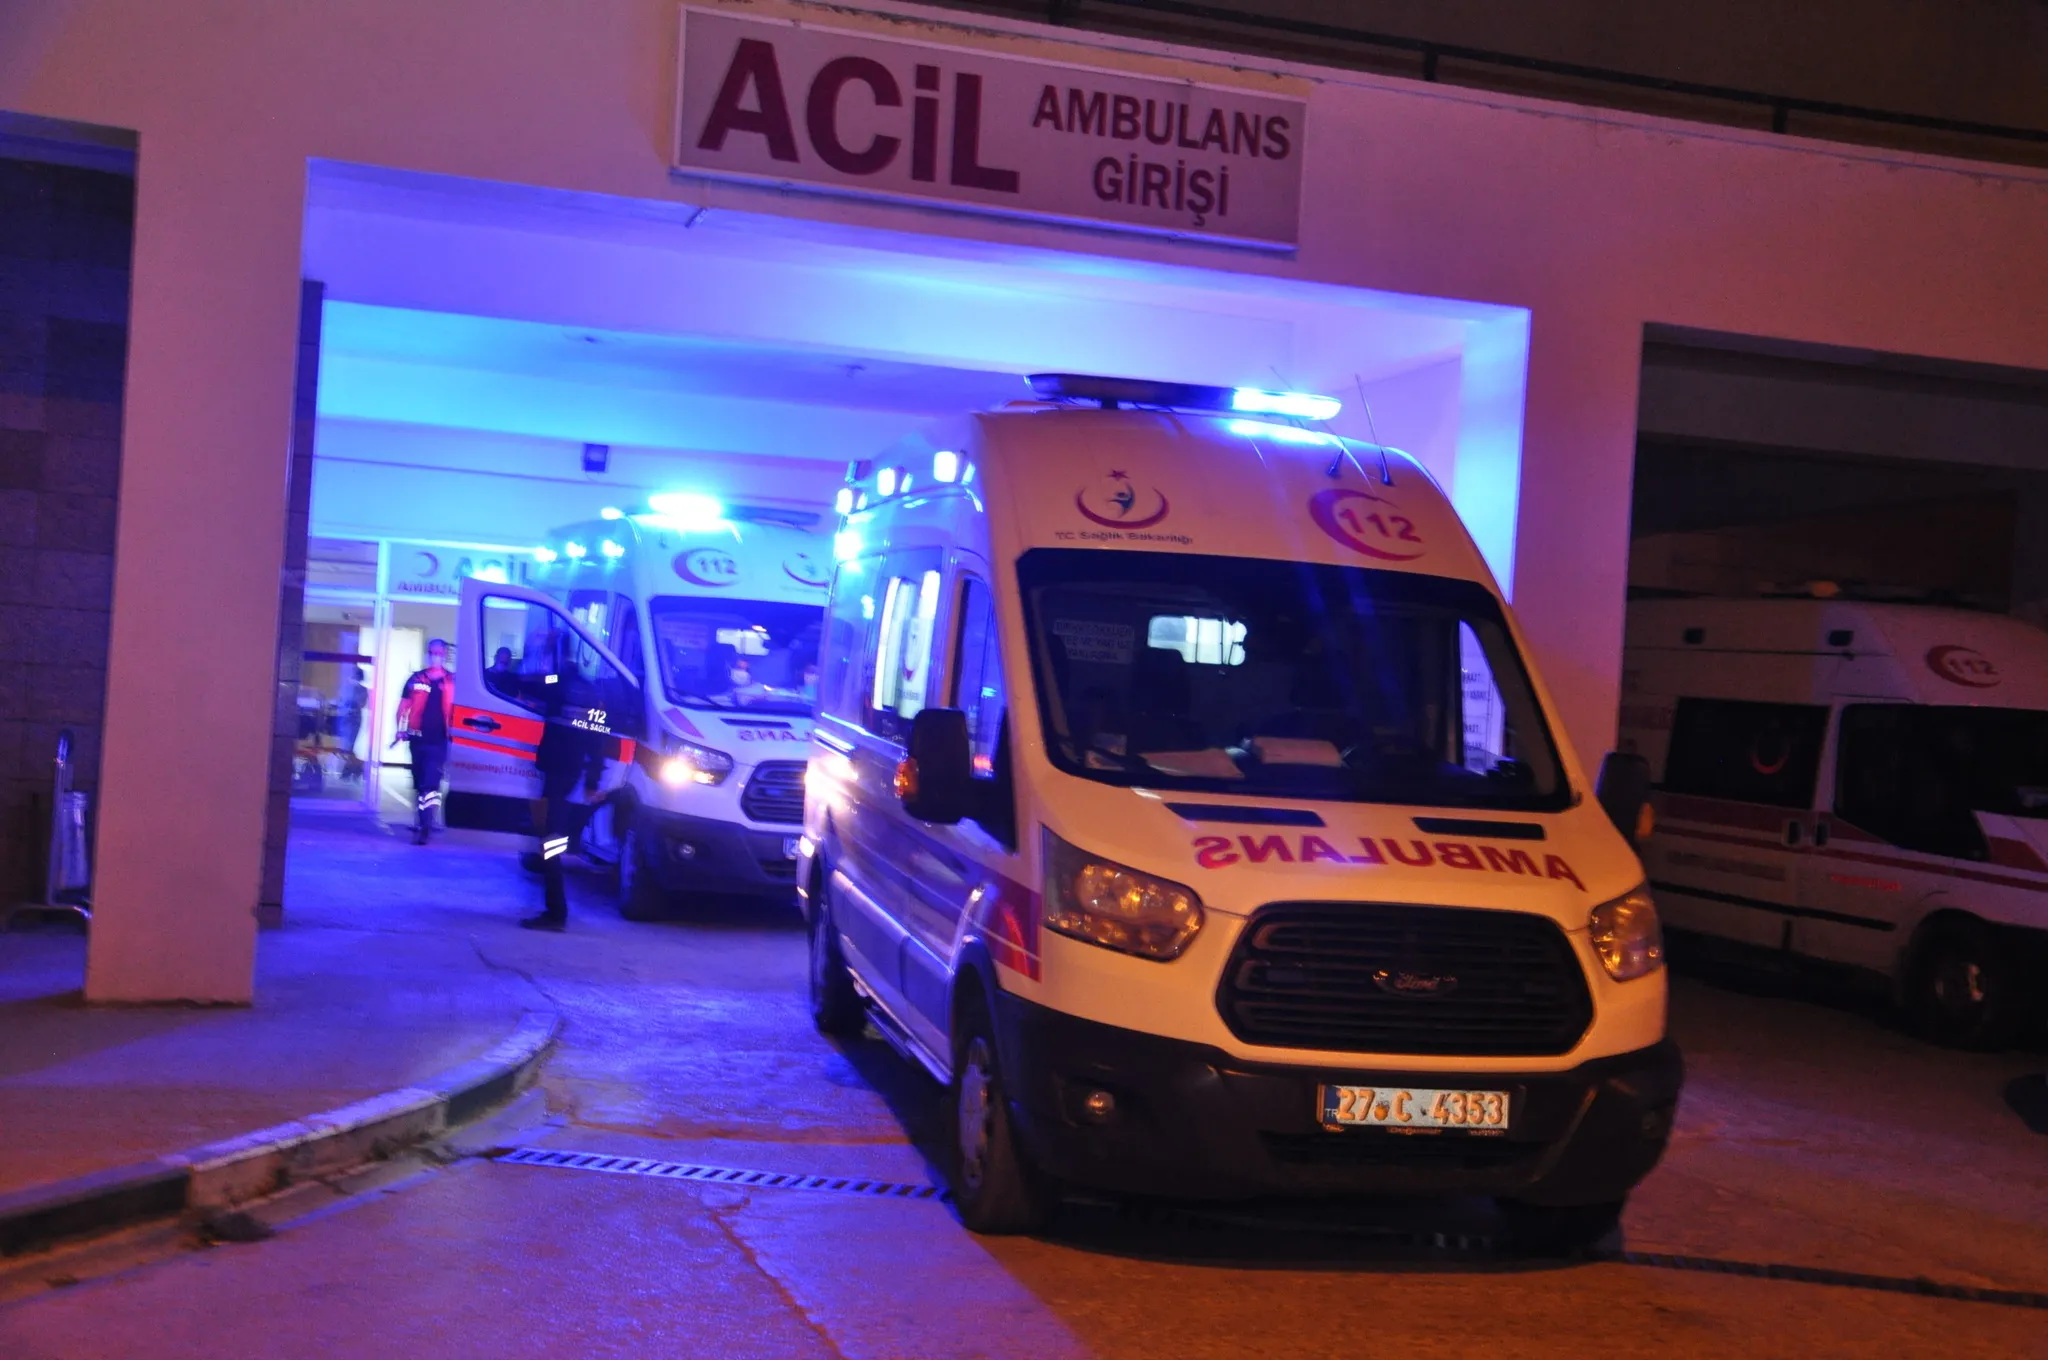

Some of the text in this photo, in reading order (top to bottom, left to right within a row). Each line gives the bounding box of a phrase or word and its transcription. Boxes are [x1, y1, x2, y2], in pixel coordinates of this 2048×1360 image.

[1033, 84, 1291, 160] AMBULANS
[1093, 153, 1229, 227] GİRİŞİ
[1338, 507, 1424, 543] 112
[696, 557, 738, 574] 112
[1948, 658, 1999, 675] 112
[587, 708, 607, 724] 112
[1337, 1087, 1503, 1125] 27 C 4353
